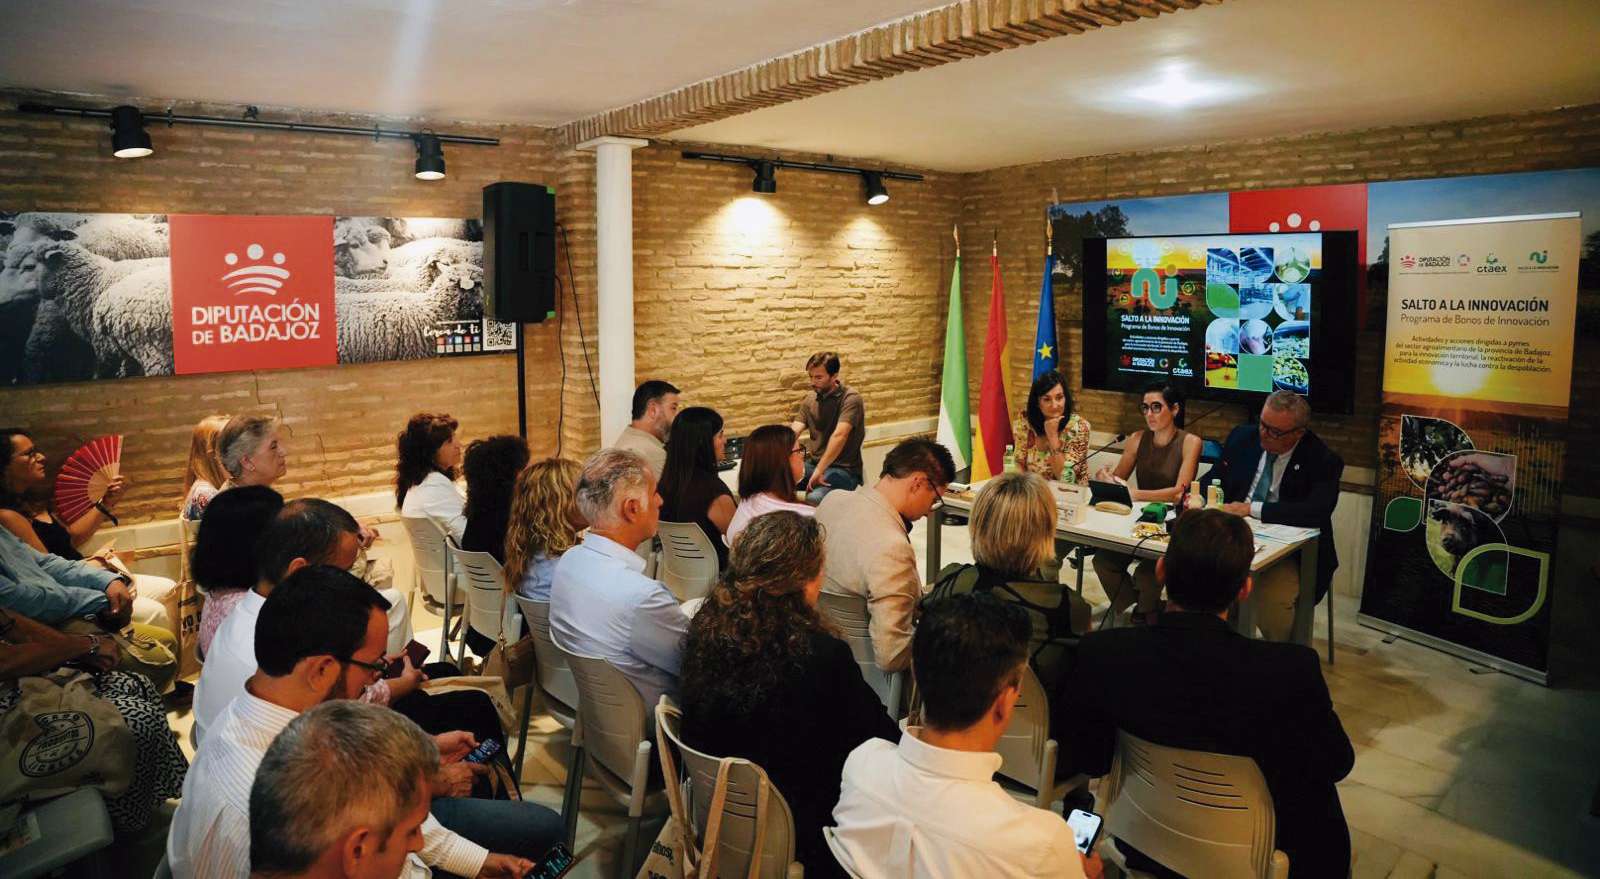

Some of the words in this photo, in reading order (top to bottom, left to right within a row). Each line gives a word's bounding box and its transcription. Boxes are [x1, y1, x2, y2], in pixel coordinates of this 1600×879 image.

[1476, 265, 1507, 273] ctaex
[191, 297, 320, 325] DIPUTACIÓN
[1401, 299, 1437, 311] SALTO
[1439, 300, 1447, 310] A
[1450, 300, 1465, 311] LA
[1468, 296, 1549, 312] INNOVACIÓN
[1145, 315, 1152, 323] LA
[1153, 315, 1190, 324] INNOVACIÓN
[1400, 313, 1440, 325] Programa
[1442, 315, 1453, 324] de
[1455, 315, 1482, 325] Bonos
[1484, 316, 1495, 325] de
[1498, 316, 1550, 326] Innovación
[191, 330, 214, 345] DE
[220, 321, 321, 344] BADAJOZ
